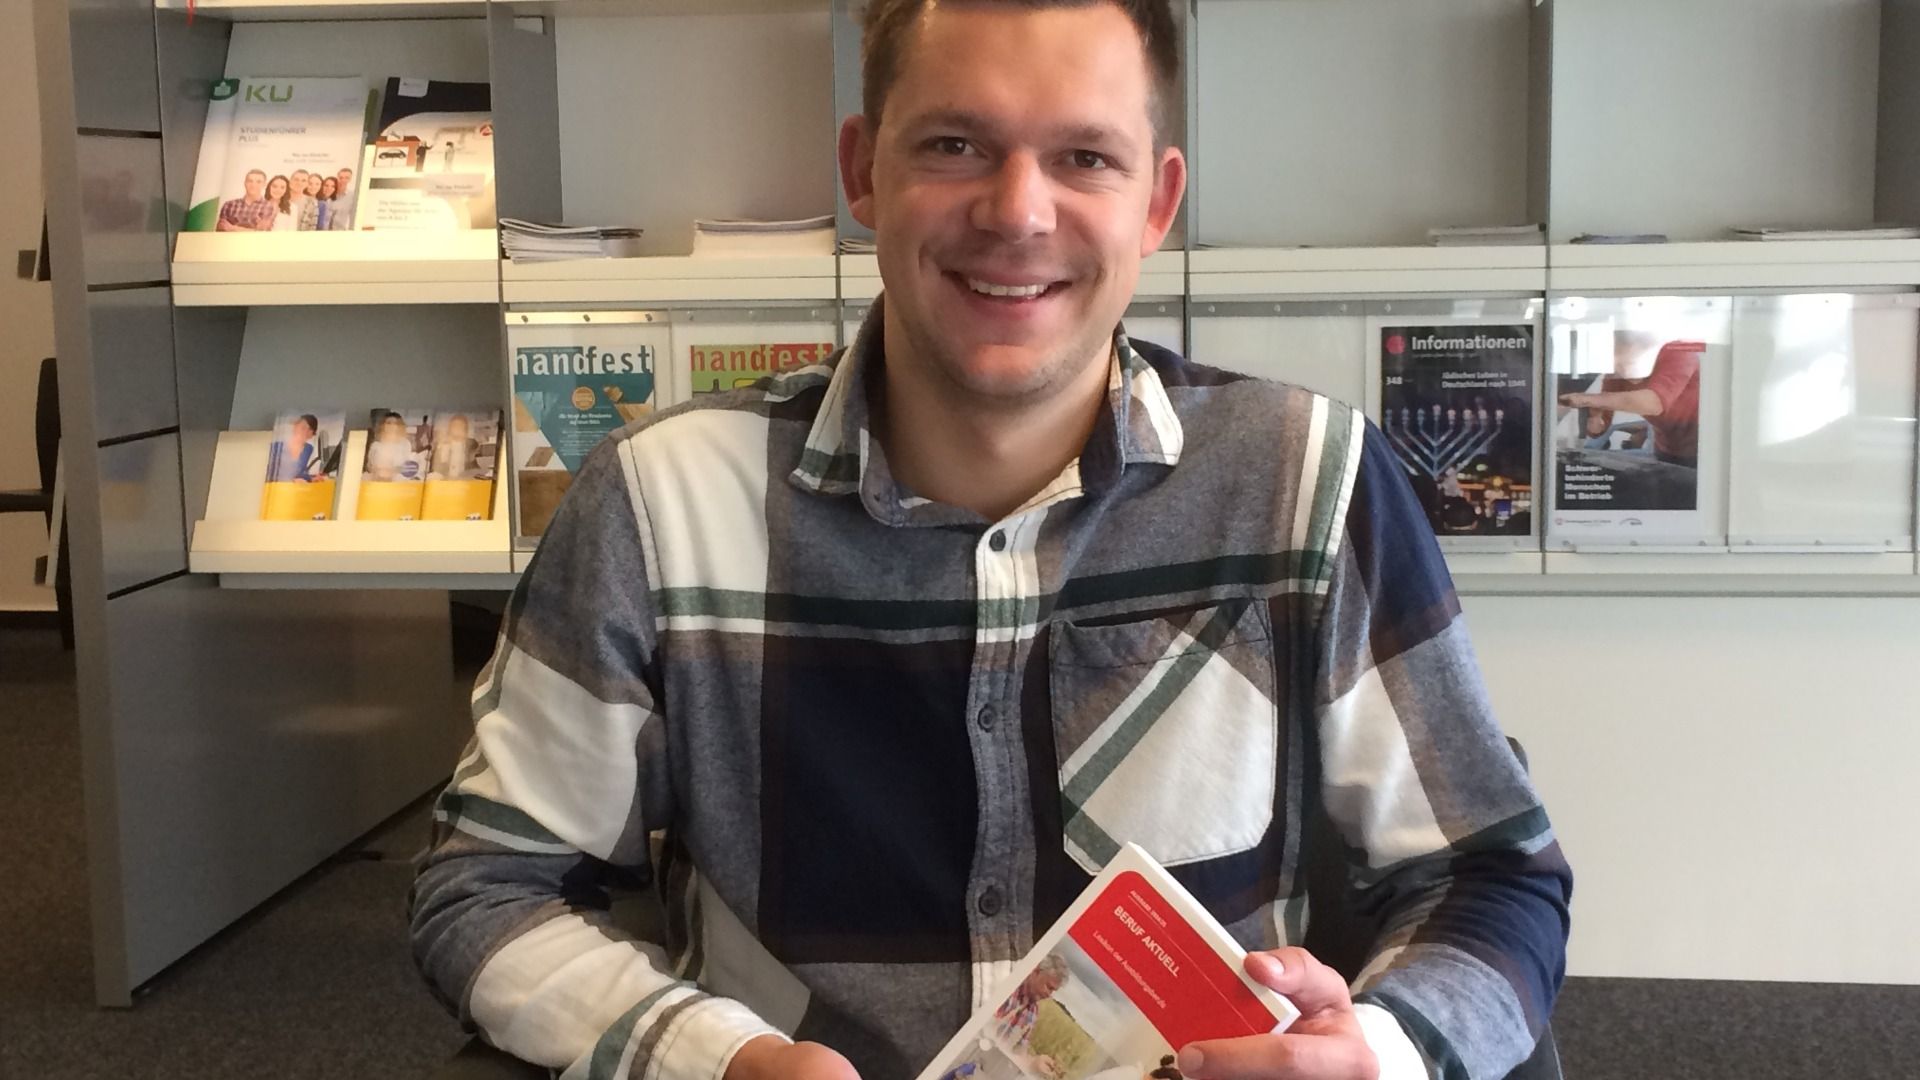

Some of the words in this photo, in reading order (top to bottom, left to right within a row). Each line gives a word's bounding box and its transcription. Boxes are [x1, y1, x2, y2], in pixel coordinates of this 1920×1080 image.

[245, 85, 293, 102] KU
[1411, 335, 1527, 350] Informationen
[514, 345, 652, 375] handfest
[1386, 376, 1403, 385] 348
[1113, 905, 1146, 936] BERUF
[1141, 935, 1180, 978] AKTUELL
